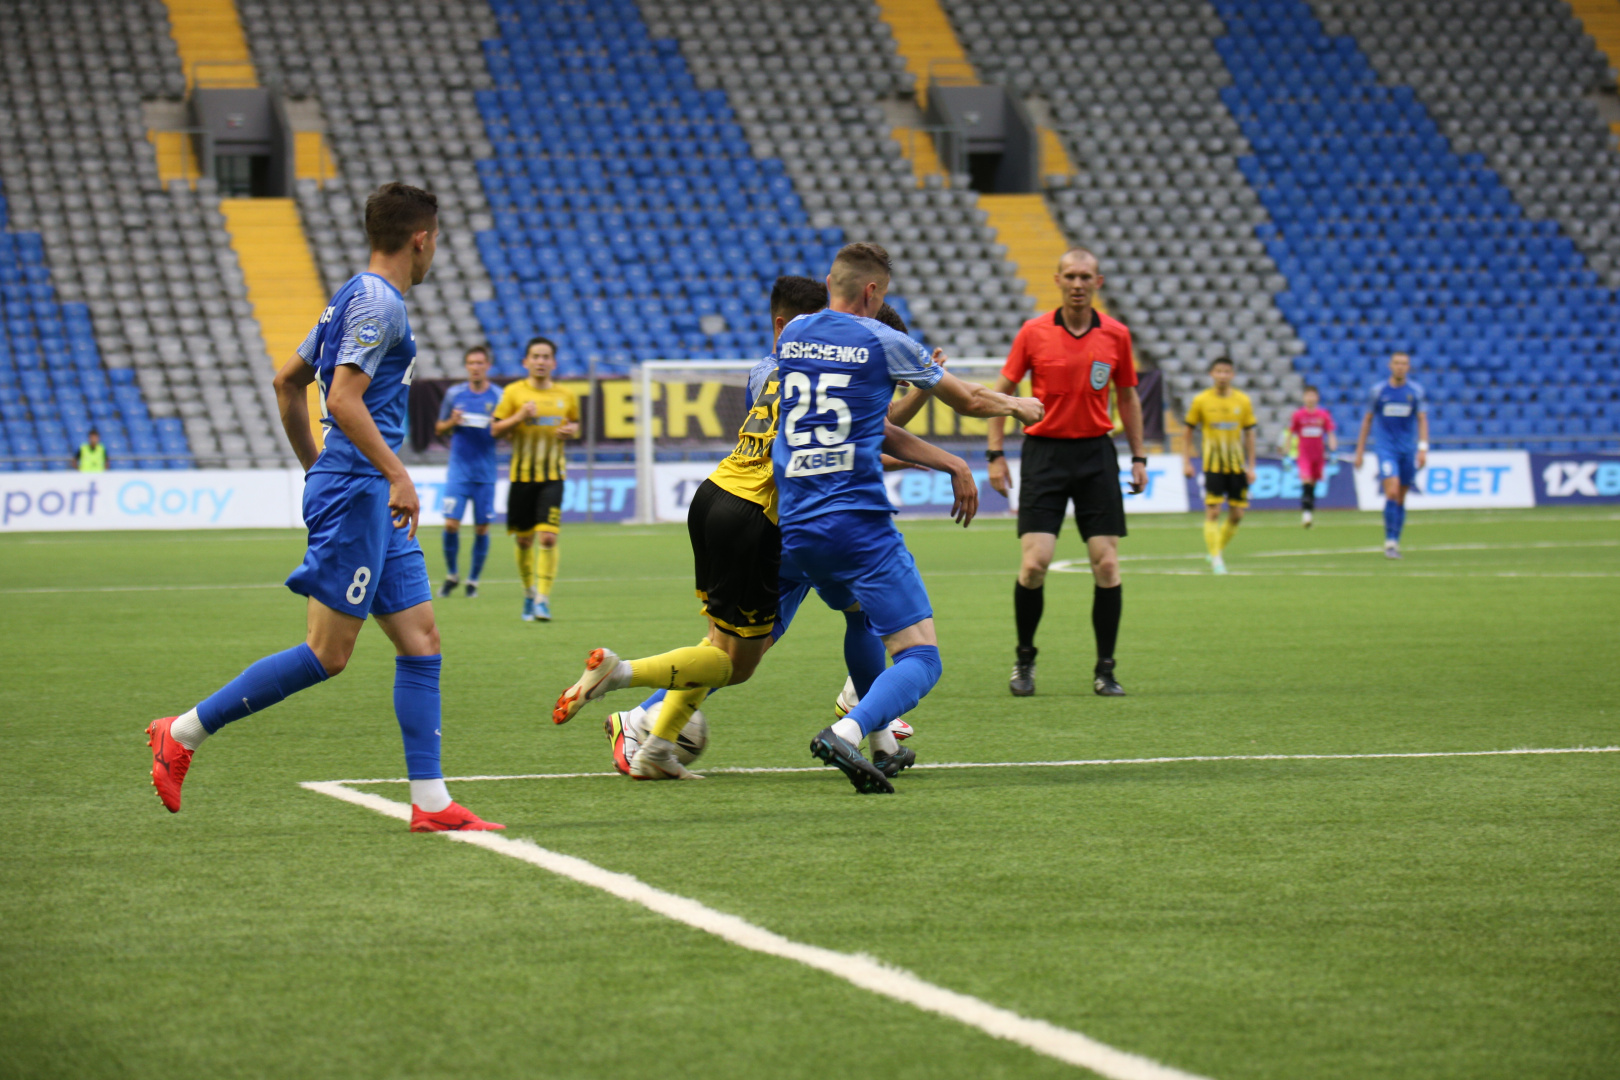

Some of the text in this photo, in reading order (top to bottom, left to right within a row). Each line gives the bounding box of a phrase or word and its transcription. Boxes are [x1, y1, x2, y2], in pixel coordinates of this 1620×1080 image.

[784, 371, 852, 446] 25
[1197, 466, 1340, 498] BET
[1376, 466, 1511, 496] BET
[3, 479, 234, 525] port Qory
[346, 566, 371, 604] 8
